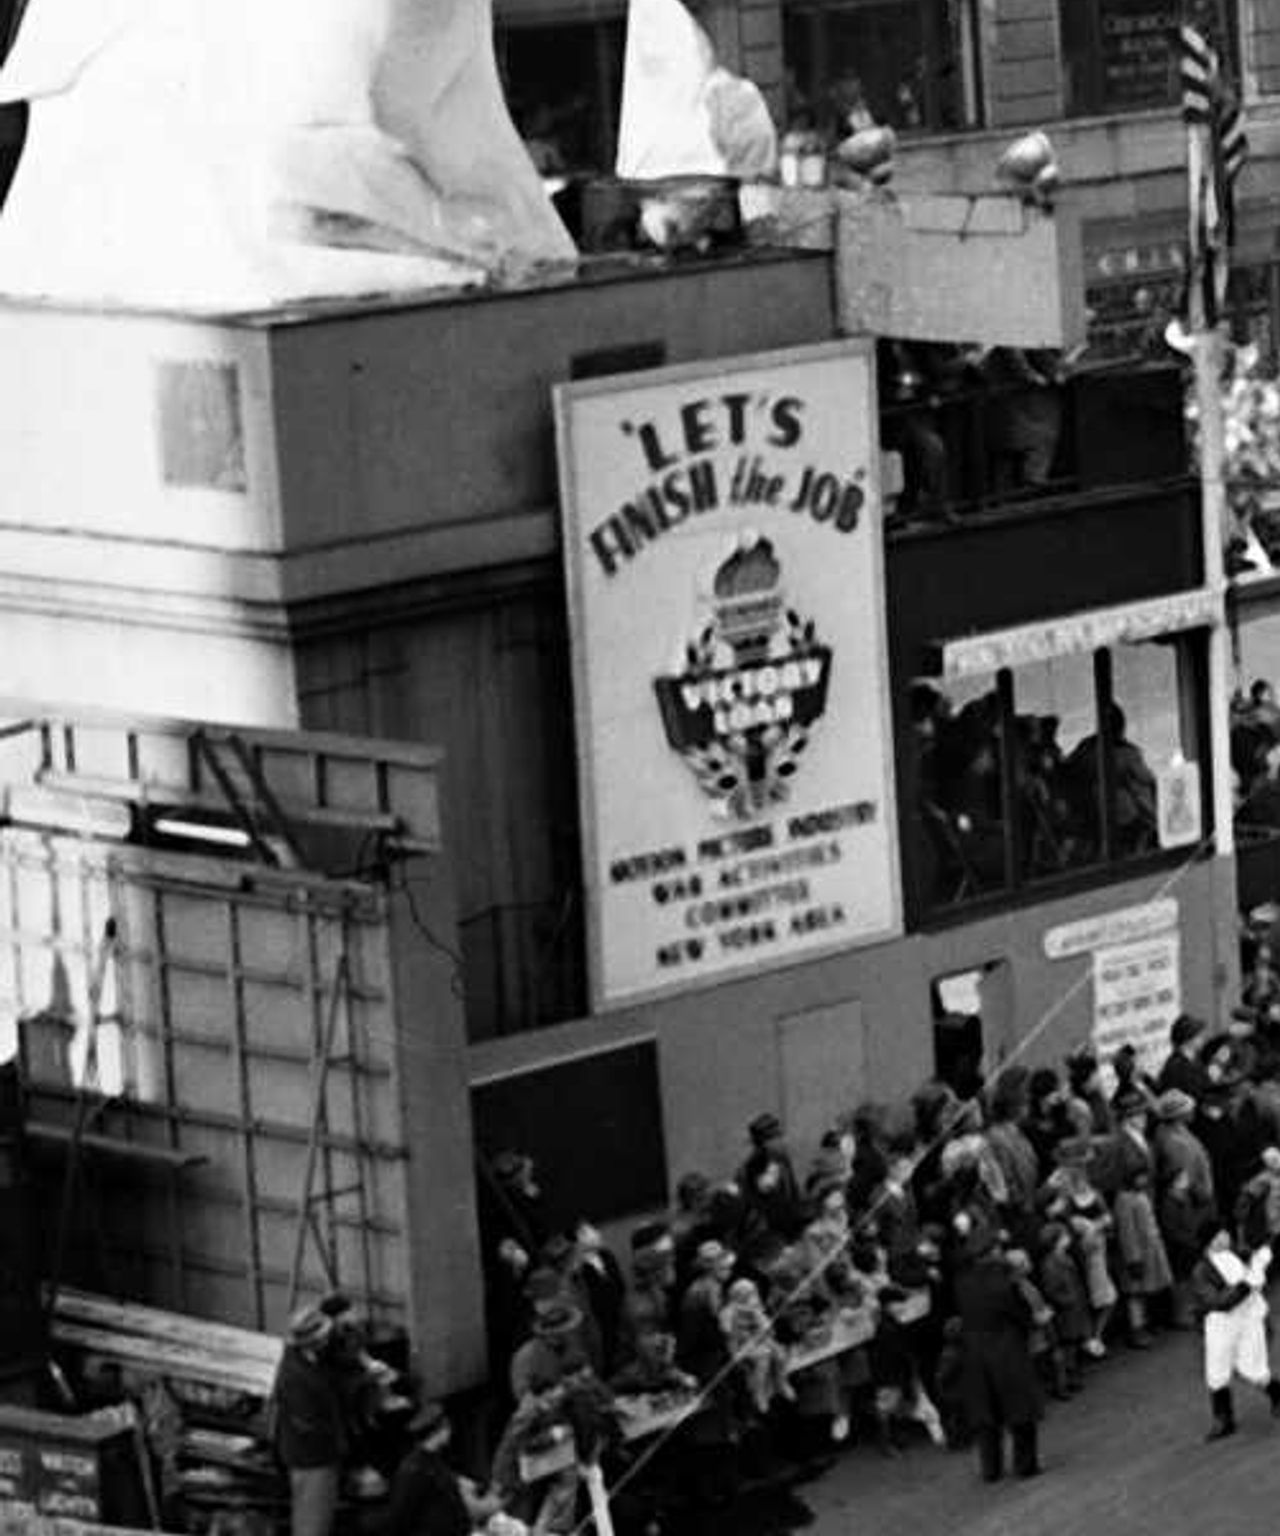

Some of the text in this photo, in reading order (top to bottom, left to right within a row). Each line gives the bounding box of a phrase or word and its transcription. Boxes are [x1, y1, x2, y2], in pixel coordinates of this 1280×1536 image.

[589, 458, 719, 577] FINISH
[729, 455, 785, 506] the
[681, 657, 822, 712] VICTORY
[713, 695, 793, 734] LOAN
[656, 937, 705, 966] NEW
[719, 920, 776, 949] YORK
